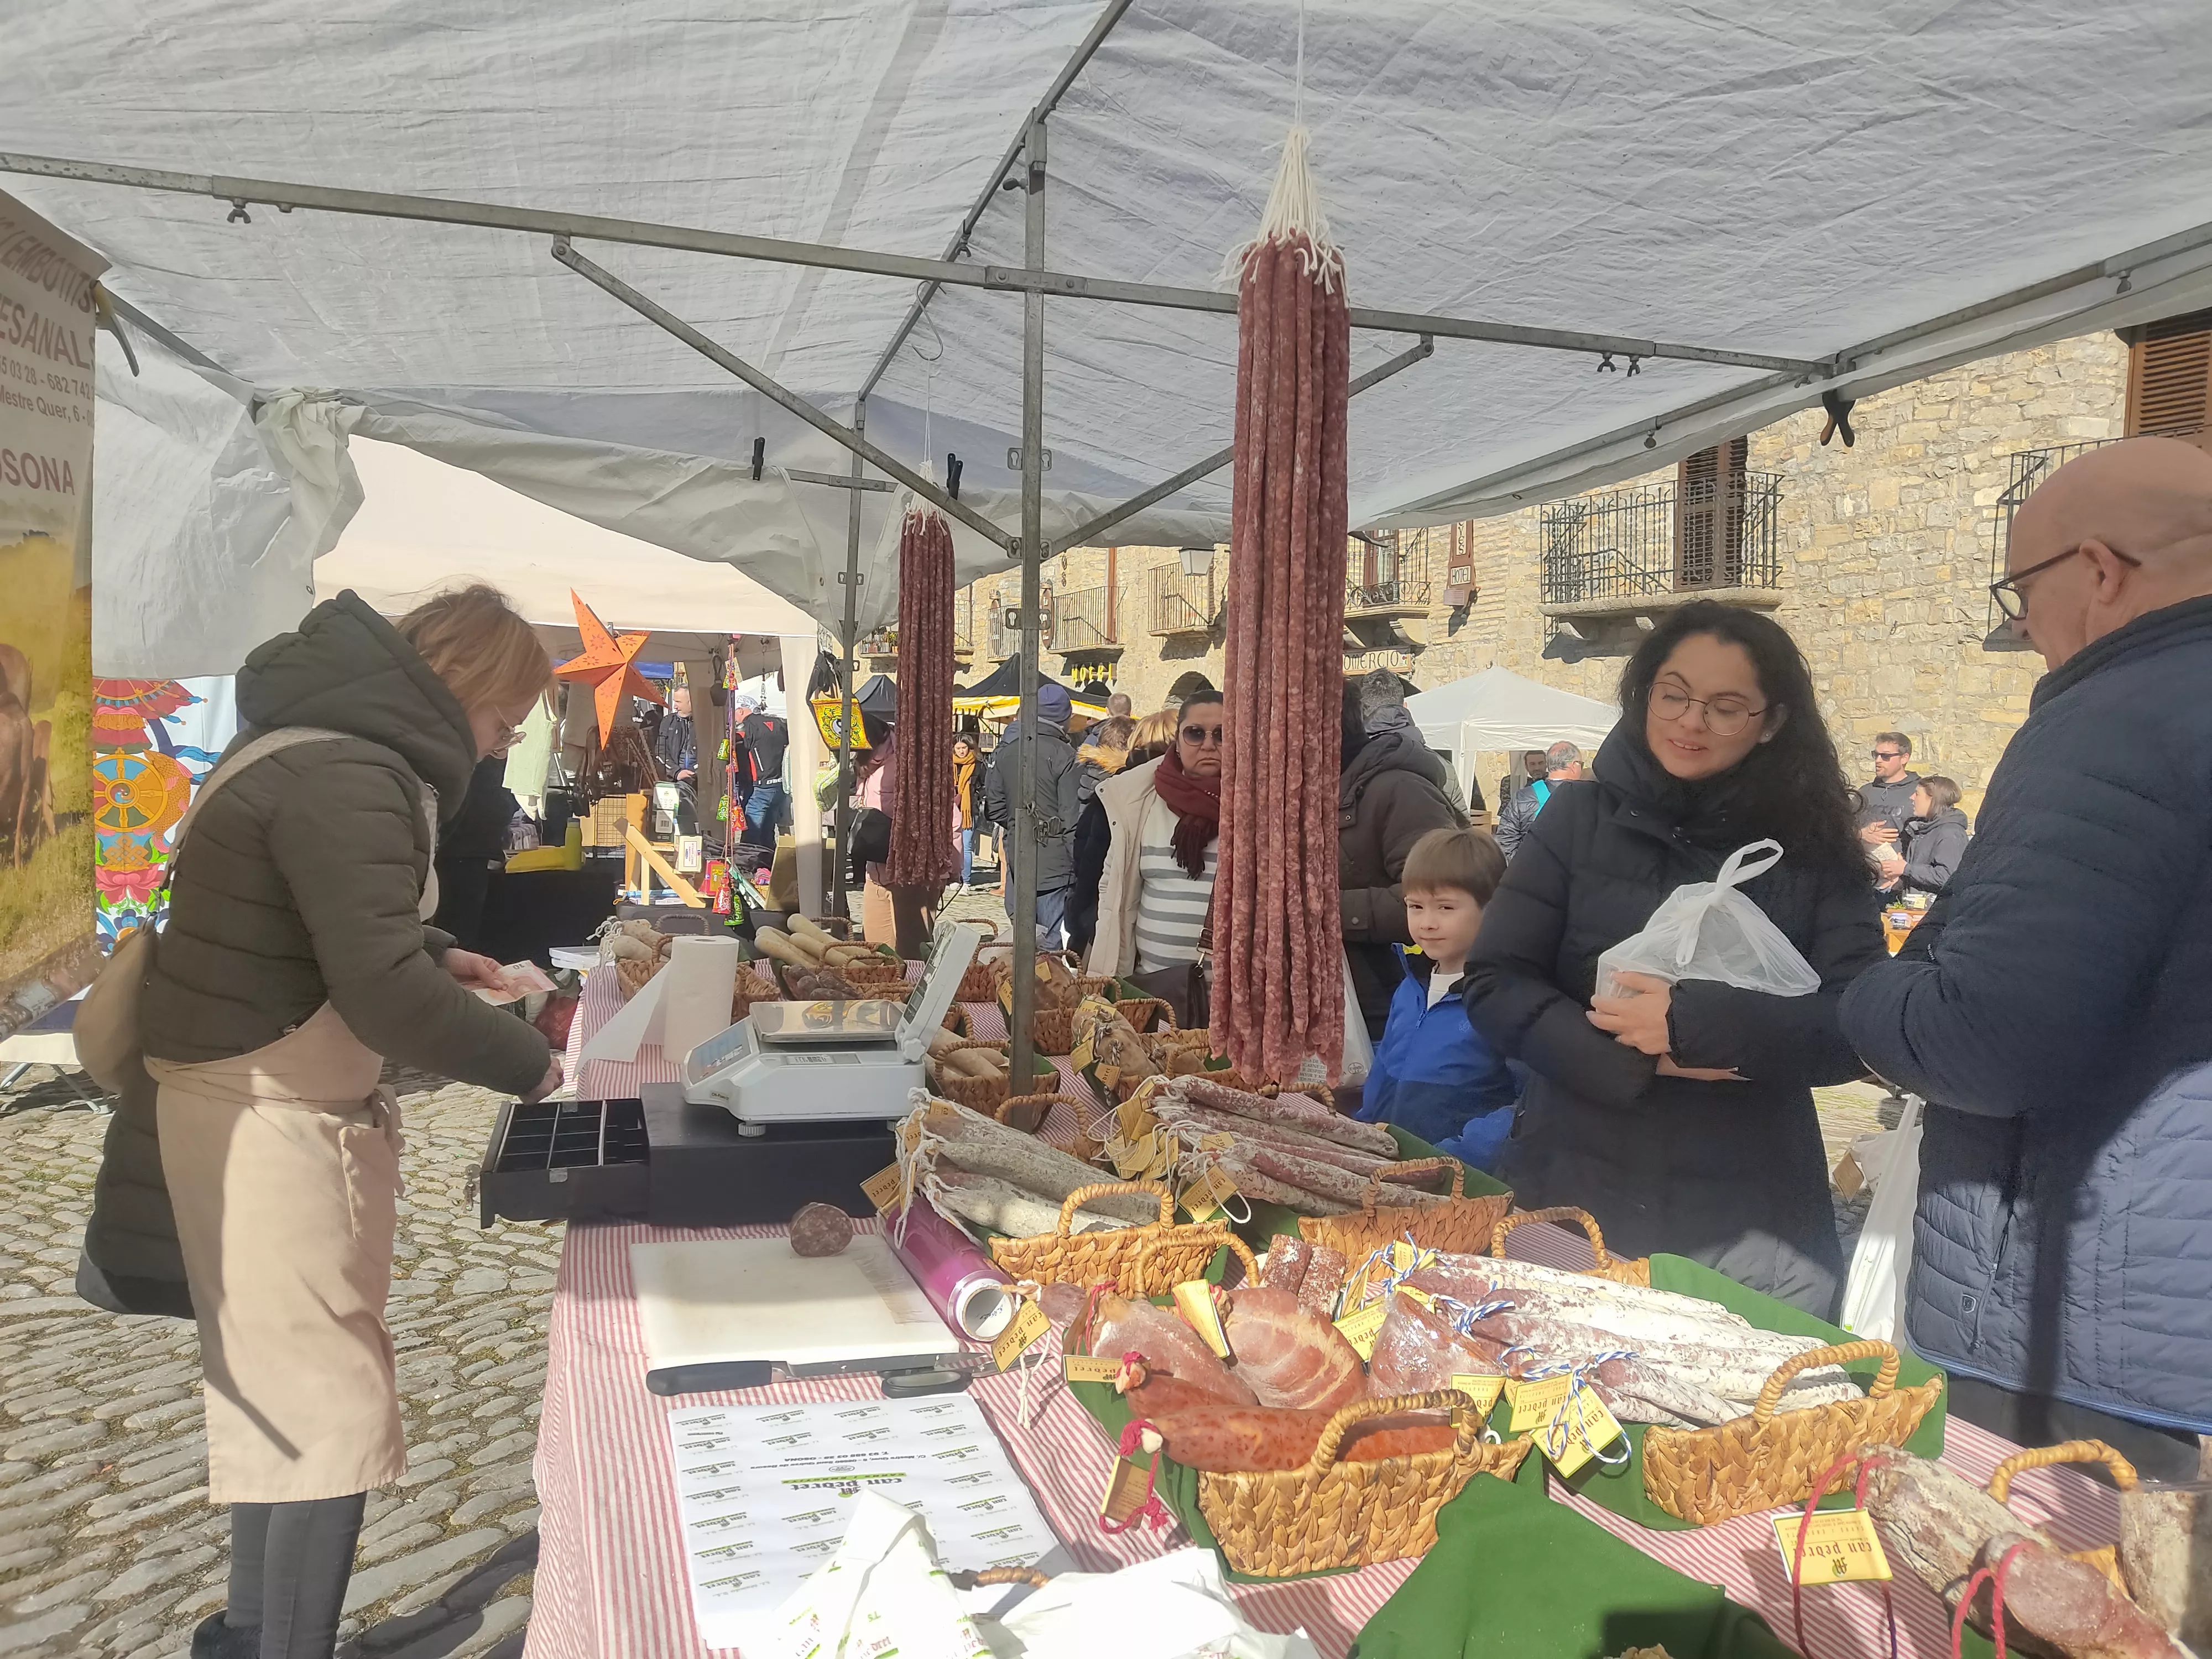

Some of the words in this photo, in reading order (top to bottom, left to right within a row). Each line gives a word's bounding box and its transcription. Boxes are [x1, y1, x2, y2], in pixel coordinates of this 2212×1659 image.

[2, 235, 91, 314] EMBOTITS
[10, 360, 22, 380] 03
[24, 366, 37, 386] 28
[47, 372, 71, 394] 682
[36, 396, 71, 424] Quer,
[73, 405, 80, 422] 6
[0, 448, 76, 496] SONA
[1452, 567, 1470, 584] HOTEL
[1343, 651, 1399, 670] OMERCIO
[1213, 1177, 1226, 1190] can
[1191, 1190, 1213, 1212] pedret
[1026, 1312, 1042, 1327] can
[998, 1326, 1024, 1357] pedret
[1348, 1327, 1375, 1345] pedre
[1476, 1397, 1493, 1409] ped
[1518, 1397, 1547, 1414] pedret
[1552, 1395, 1566, 1405] can
[1584, 1410, 1604, 1428] can
[790, 1479, 859, 1491] pedret
[1793, 1541, 1841, 1558] pedre
[1848, 1542, 1872, 1553] can
